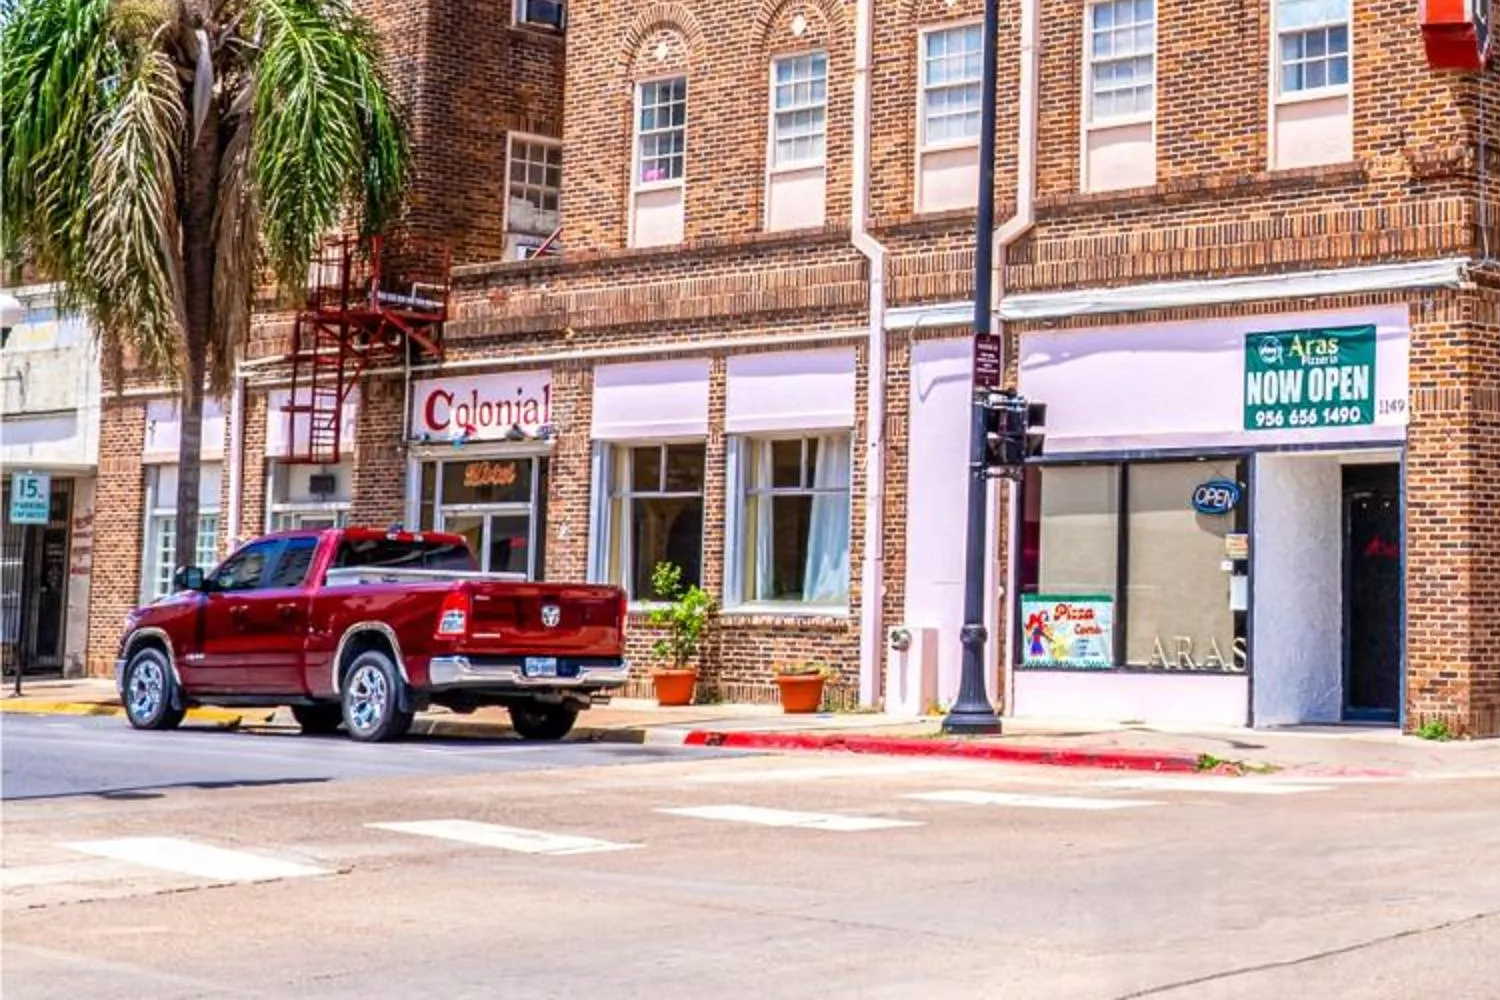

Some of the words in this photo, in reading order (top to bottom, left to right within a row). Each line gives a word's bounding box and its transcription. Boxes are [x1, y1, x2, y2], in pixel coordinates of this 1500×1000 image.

[1289, 334, 1339, 356] Aras
[1302, 355, 1338, 366] Pizzeria
[1247, 368, 1304, 406] NOW
[1307, 365, 1369, 403] OPEN
[425, 384, 550, 430] Colonial
[1255, 409, 1284, 427] 956
[1289, 408, 1317, 425] 656
[1323, 407, 1361, 424] 1490
[20, 479, 38, 498] 15
[1195, 487, 1236, 508] OPEN
[1053, 604, 1094, 621] Pizza
[1149, 634, 1248, 673] ARAS
